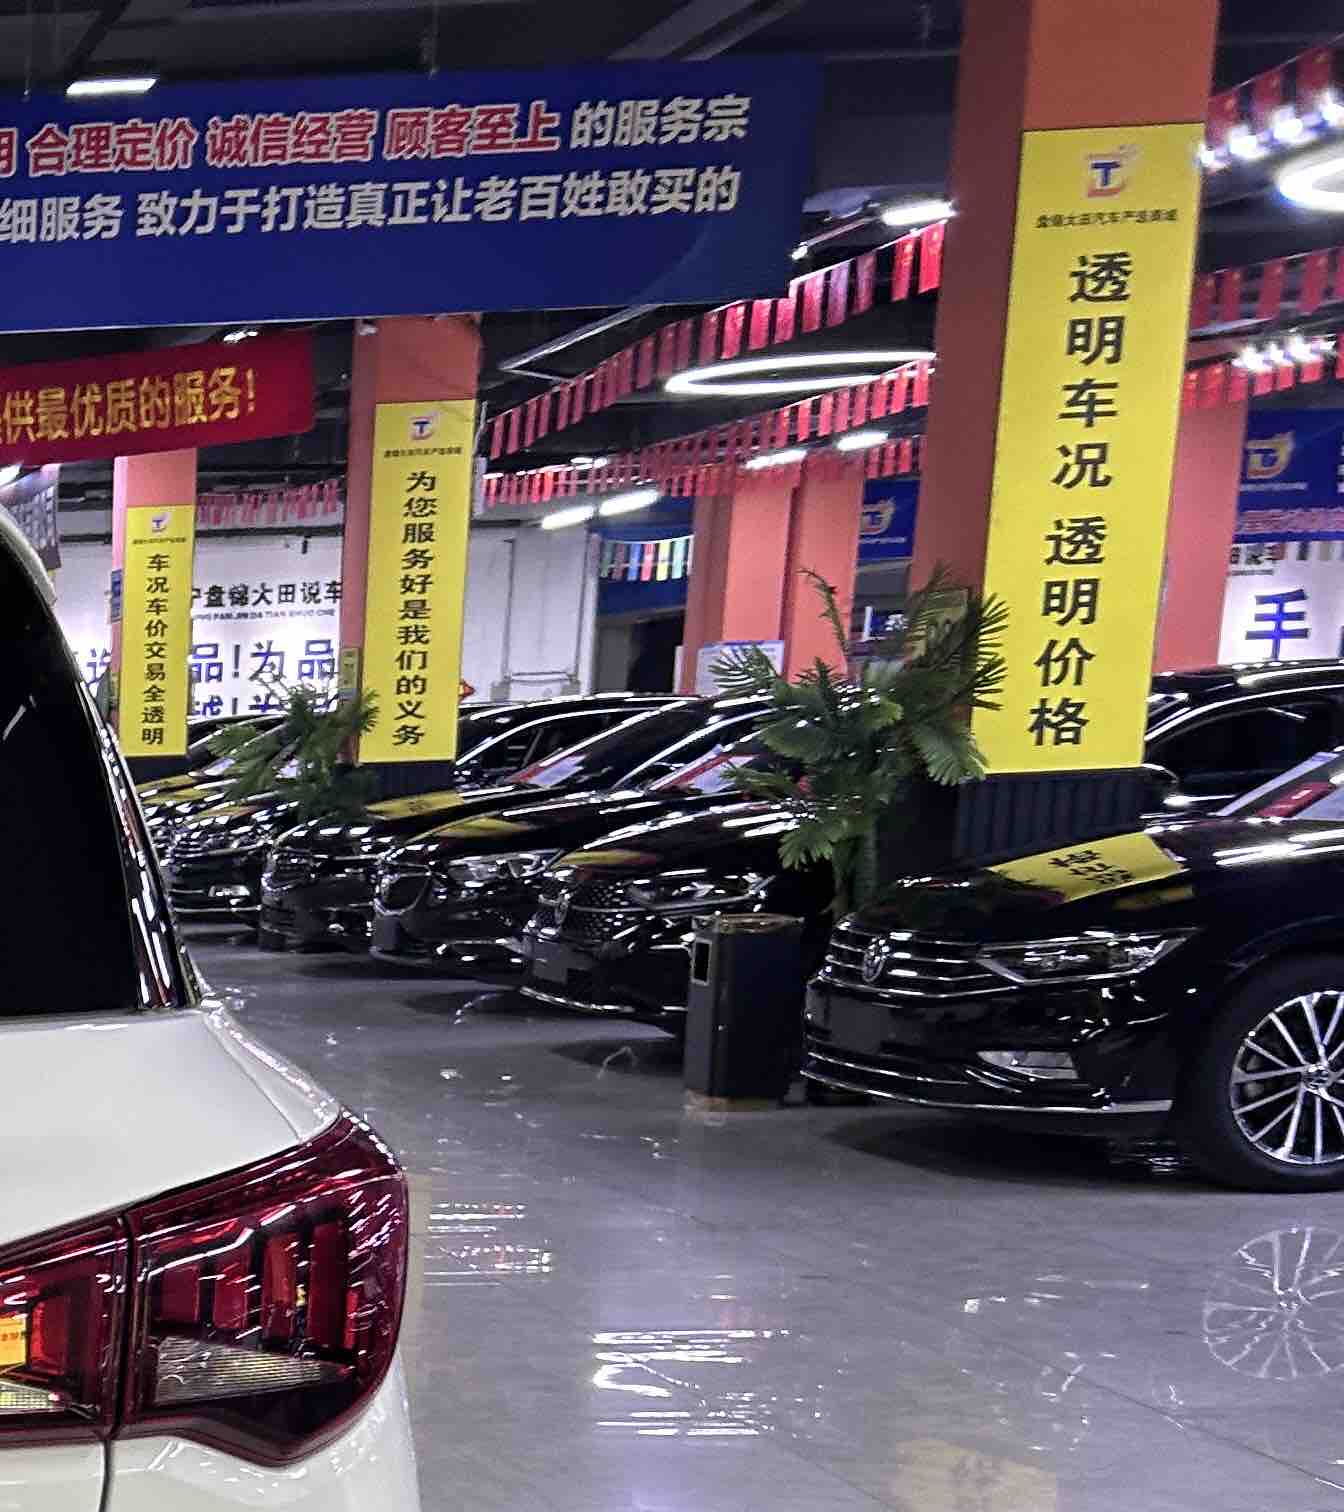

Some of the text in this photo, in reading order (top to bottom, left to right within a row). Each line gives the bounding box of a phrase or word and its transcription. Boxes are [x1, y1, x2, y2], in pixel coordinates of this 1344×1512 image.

[26, 115, 199, 177] 合理定价
[205, 108, 377, 169] 诚信经营
[383, 100, 561, 160] 顾客至上
[570, 94, 752, 149] 的服务宗
[136, 166, 742, 238] 致力于打造真正让老百姓敢买的
[1028, 252, 1132, 747] 透明车况 透明价格
[141, 553, 171, 746] 车况车价交易全透明
[390, 470, 437, 746] 为您服务好是我们的义务
